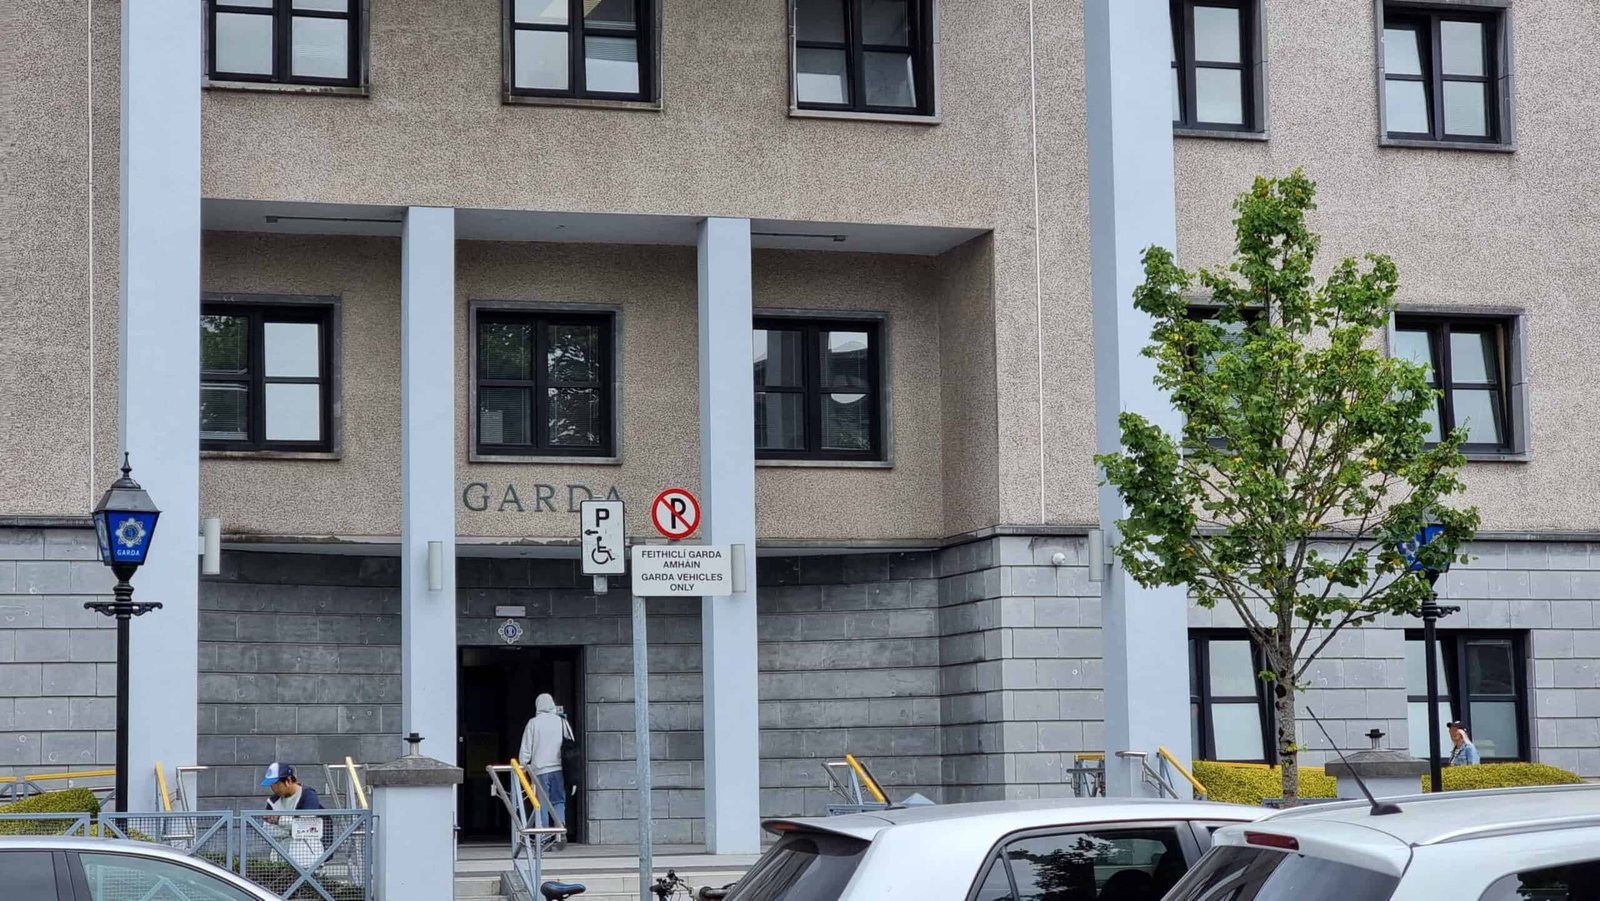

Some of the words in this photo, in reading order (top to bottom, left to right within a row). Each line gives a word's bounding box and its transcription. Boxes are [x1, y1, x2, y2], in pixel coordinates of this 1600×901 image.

[595, 508, 610, 527] P
[671, 498, 686, 529] P
[641, 548, 686, 559] FEITHICLÍ
[688, 550, 722, 559] GARDA
[663, 559, 701, 569] AMHÁIN
[641, 573, 675, 581] GARDA
[677, 573, 723, 581] VEHICLES
[670, 583, 695, 592] ONLY
